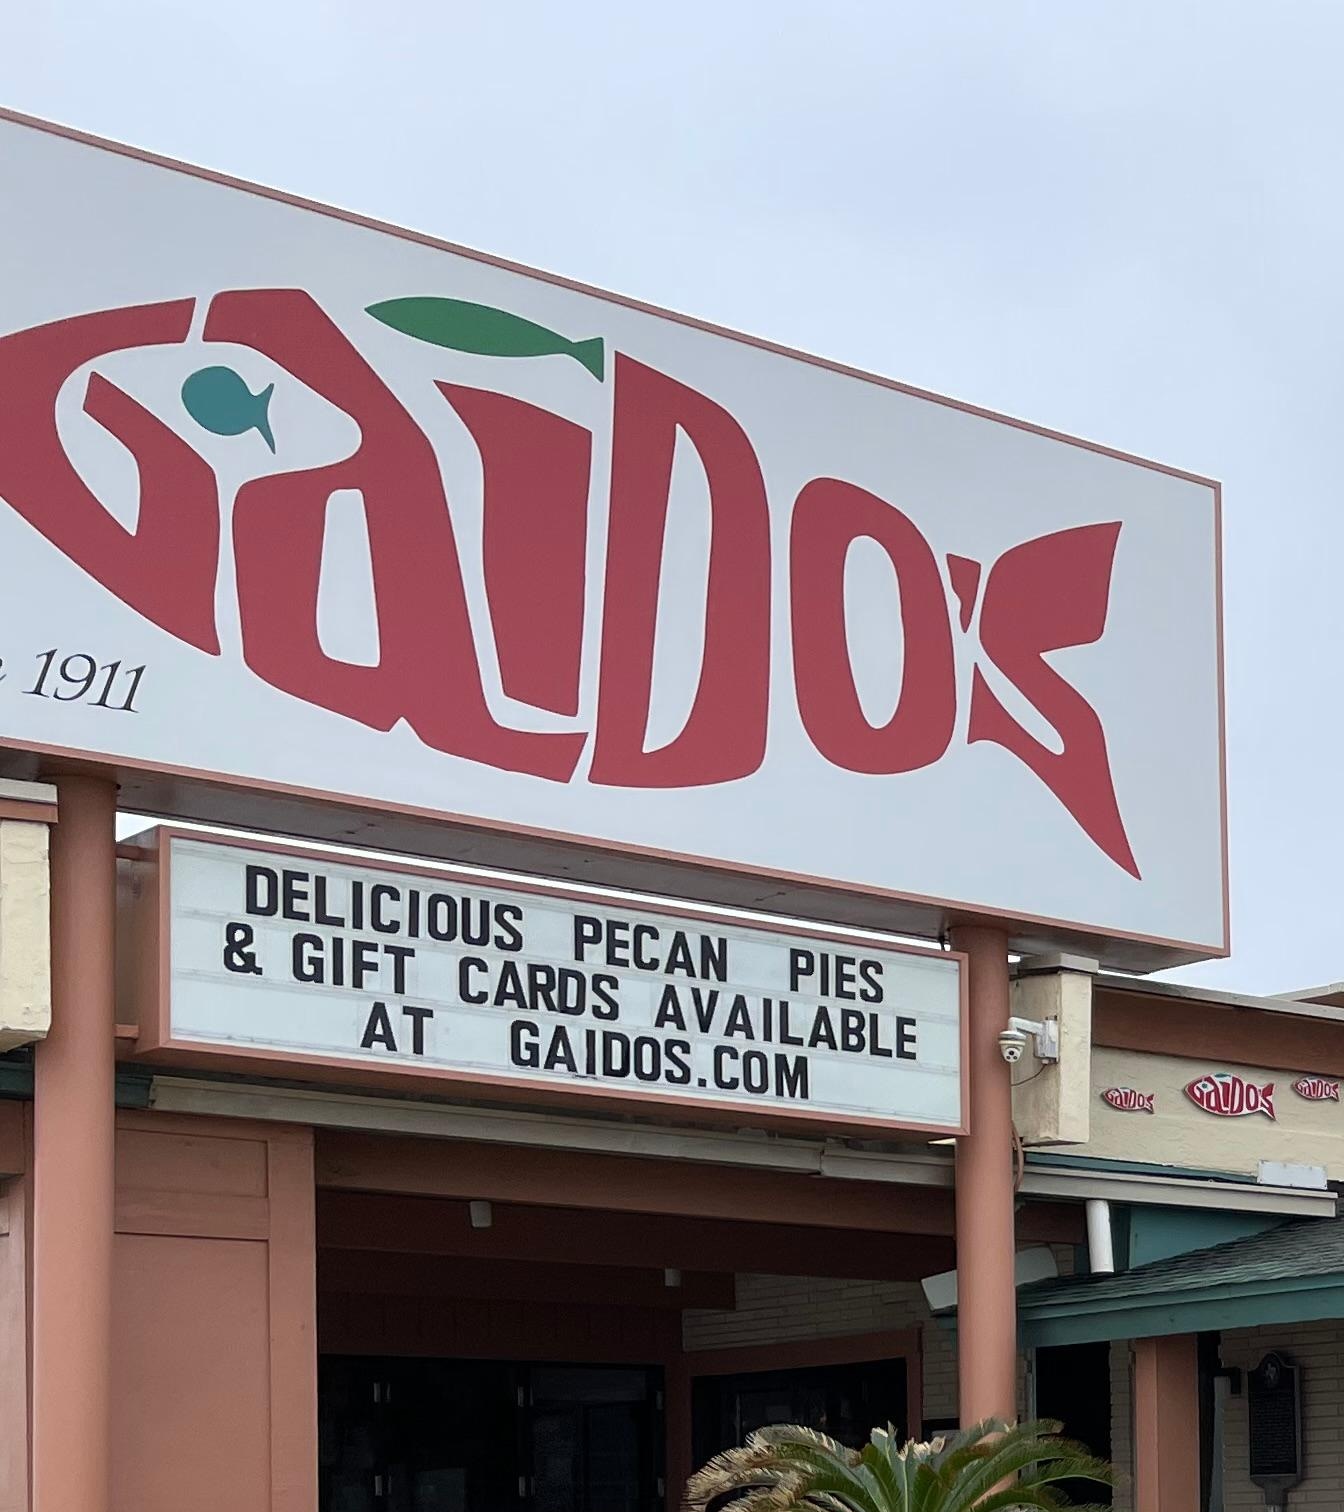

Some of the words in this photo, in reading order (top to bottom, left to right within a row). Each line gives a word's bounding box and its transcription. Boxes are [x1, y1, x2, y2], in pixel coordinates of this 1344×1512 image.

[22, 648, 146, 713] 1911
[223, 921, 263, 976] &
[292, 933, 416, 995] GIFT
[458, 956, 619, 1021] CARDS
[654, 984, 917, 1060] AVAILABLE
[245, 864, 523, 952] DELICIOUS
[573, 914, 727, 982] PECAN
[789, 948, 884, 1004] PIES
[360, 1001, 434, 1056] AT
[510, 1019, 809, 1099] GAIDOS.COM
